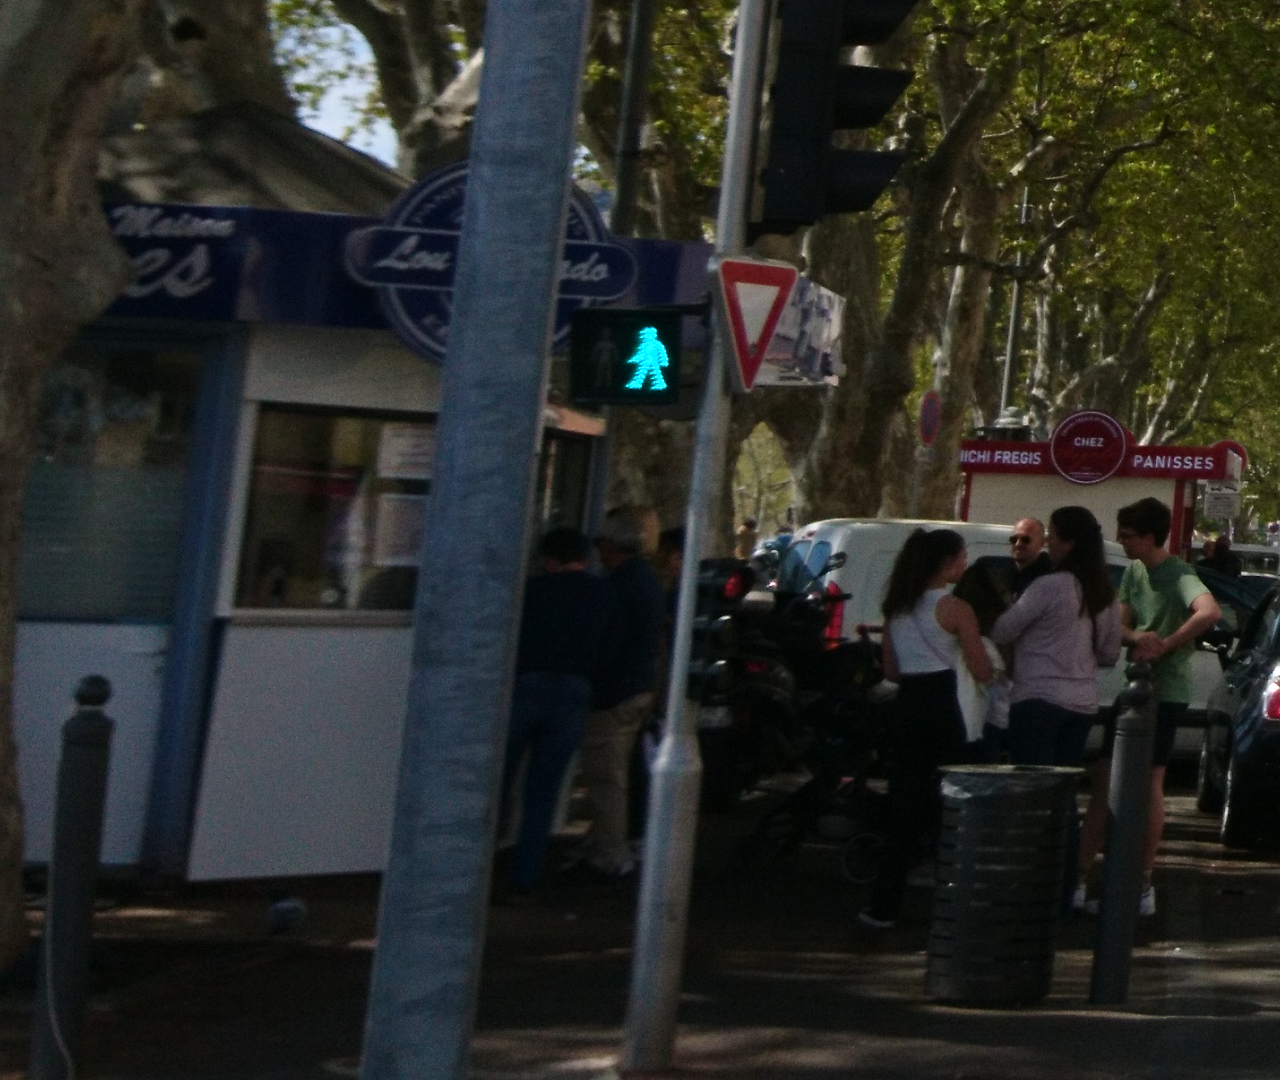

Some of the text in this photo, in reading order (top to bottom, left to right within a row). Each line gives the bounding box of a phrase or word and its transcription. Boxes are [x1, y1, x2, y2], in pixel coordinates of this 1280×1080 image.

[1074, 436, 1104, 447] CHEZ
[994, 450, 1042, 465] FREGIS
[1133, 454, 1214, 470] PANISSES
